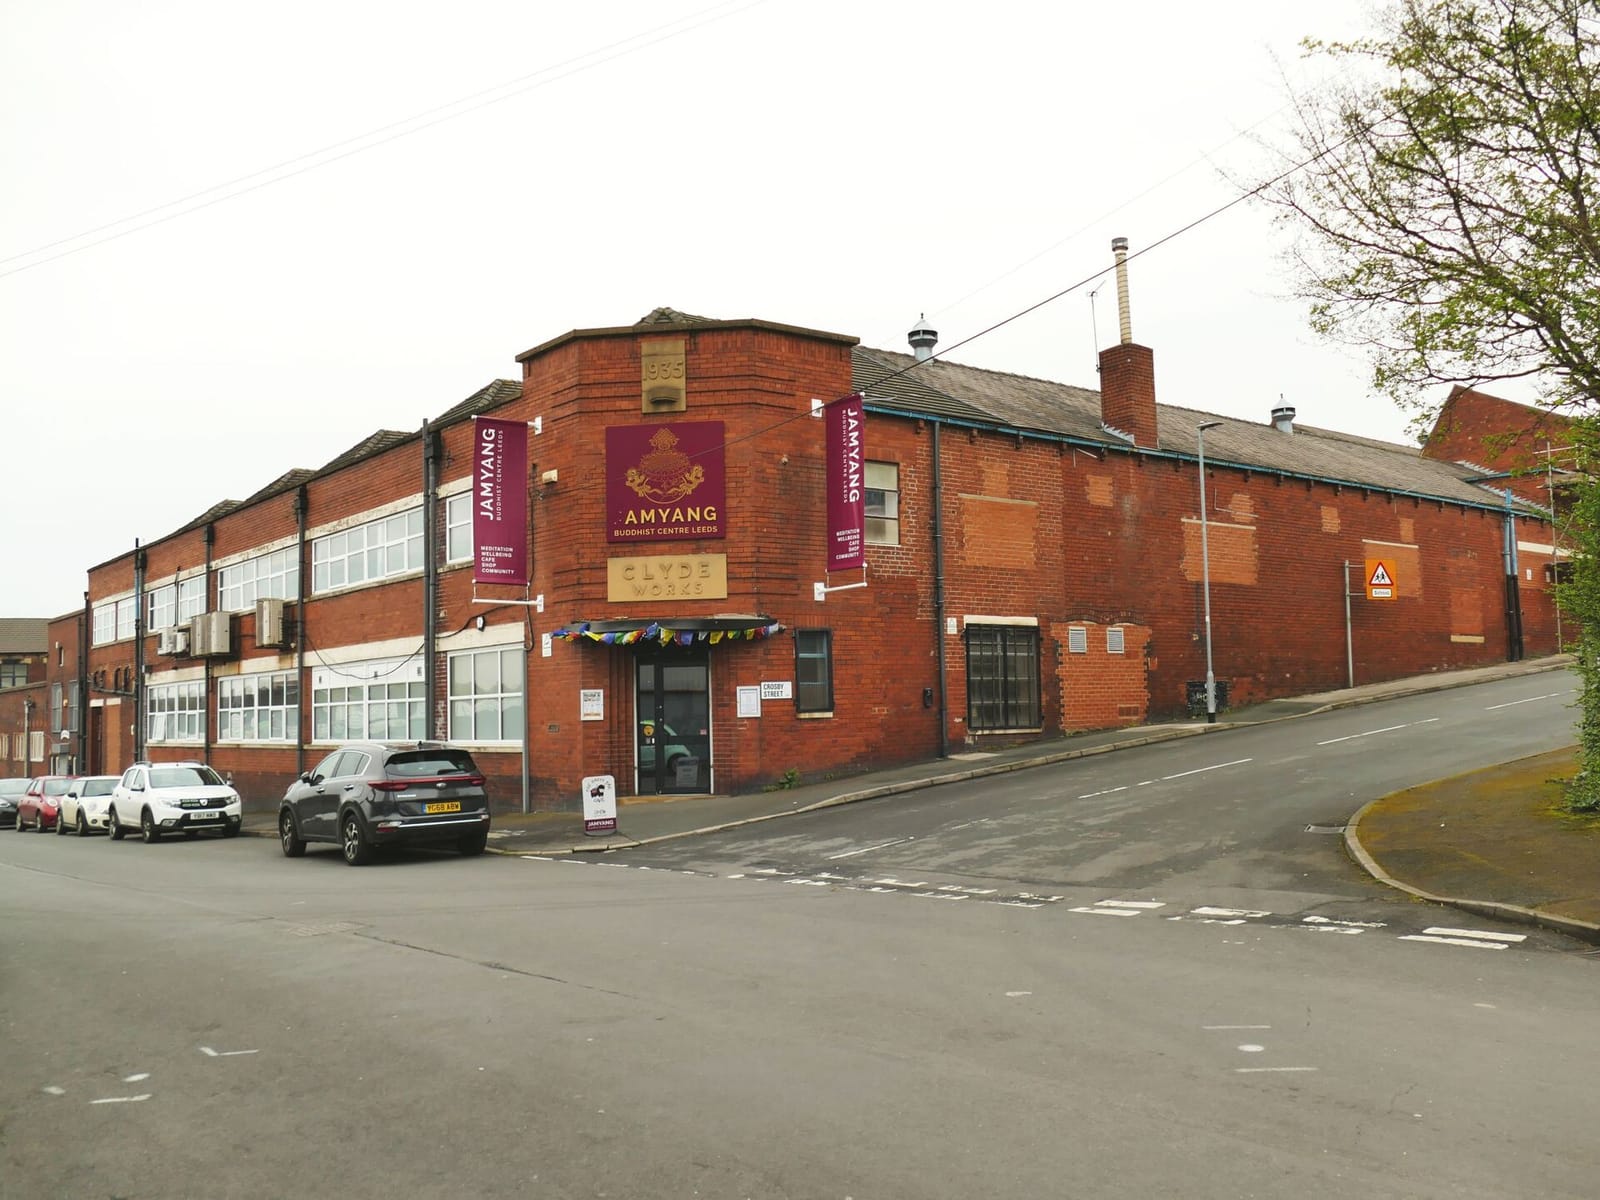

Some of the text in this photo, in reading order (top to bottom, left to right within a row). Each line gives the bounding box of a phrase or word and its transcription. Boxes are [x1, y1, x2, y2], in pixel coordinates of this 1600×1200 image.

[643, 361, 684, 381] 1935
[848, 408, 860, 503] JAMYANG
[480, 428, 495, 520] JAMYANG
[613, 525, 718, 537] BUDDHIST CENTRE LEEDS
[622, 562, 711, 581] CLYDE
[632, 582, 704, 597] WORKS
